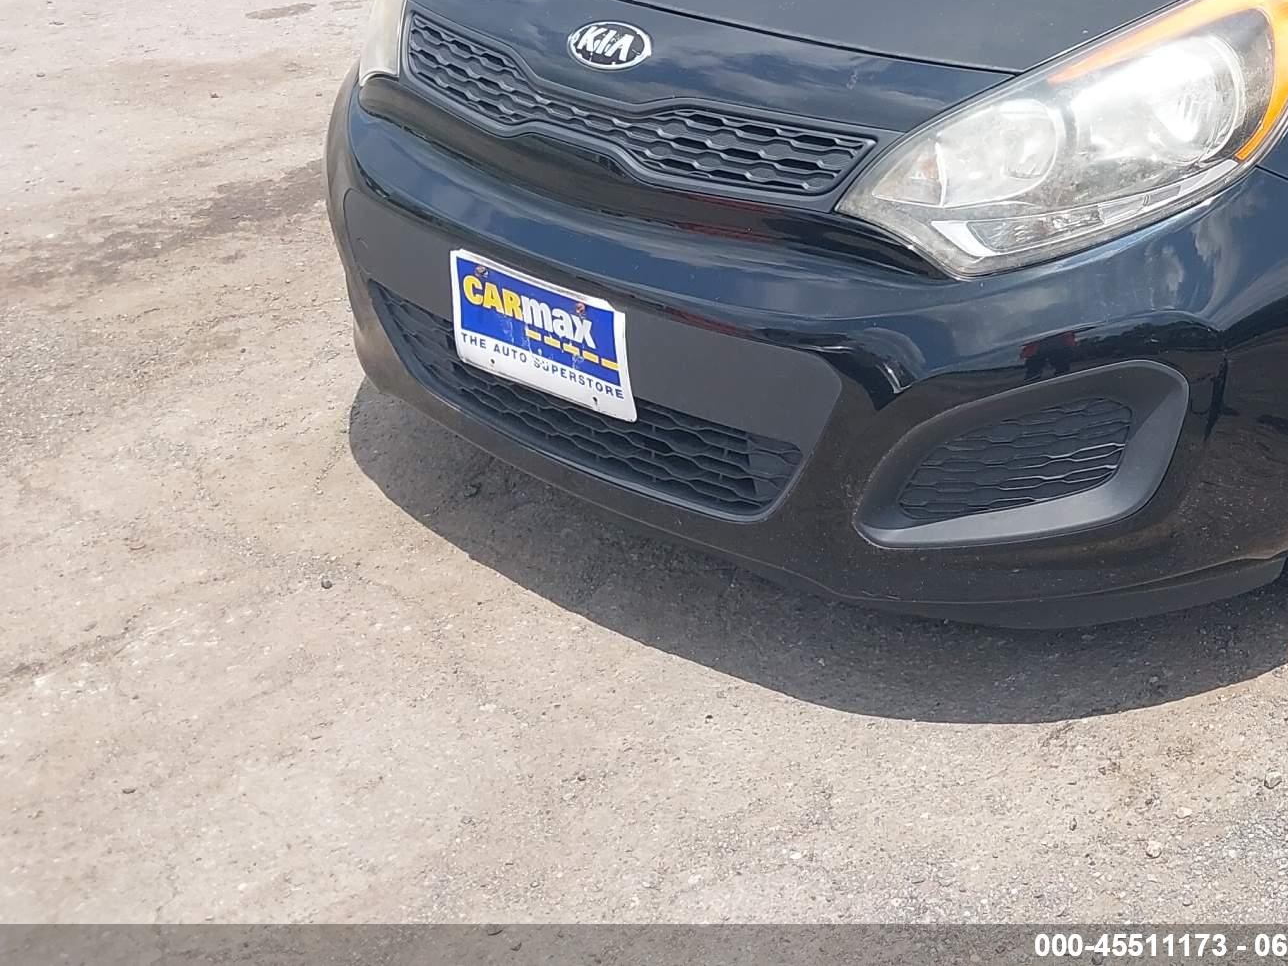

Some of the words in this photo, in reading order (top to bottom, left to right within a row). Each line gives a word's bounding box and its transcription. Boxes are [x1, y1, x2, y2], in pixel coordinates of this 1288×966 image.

[461, 333, 487, 349] THE
[493, 343, 528, 364] AUTO
[533, 355, 625, 400] SUPERSTORE
